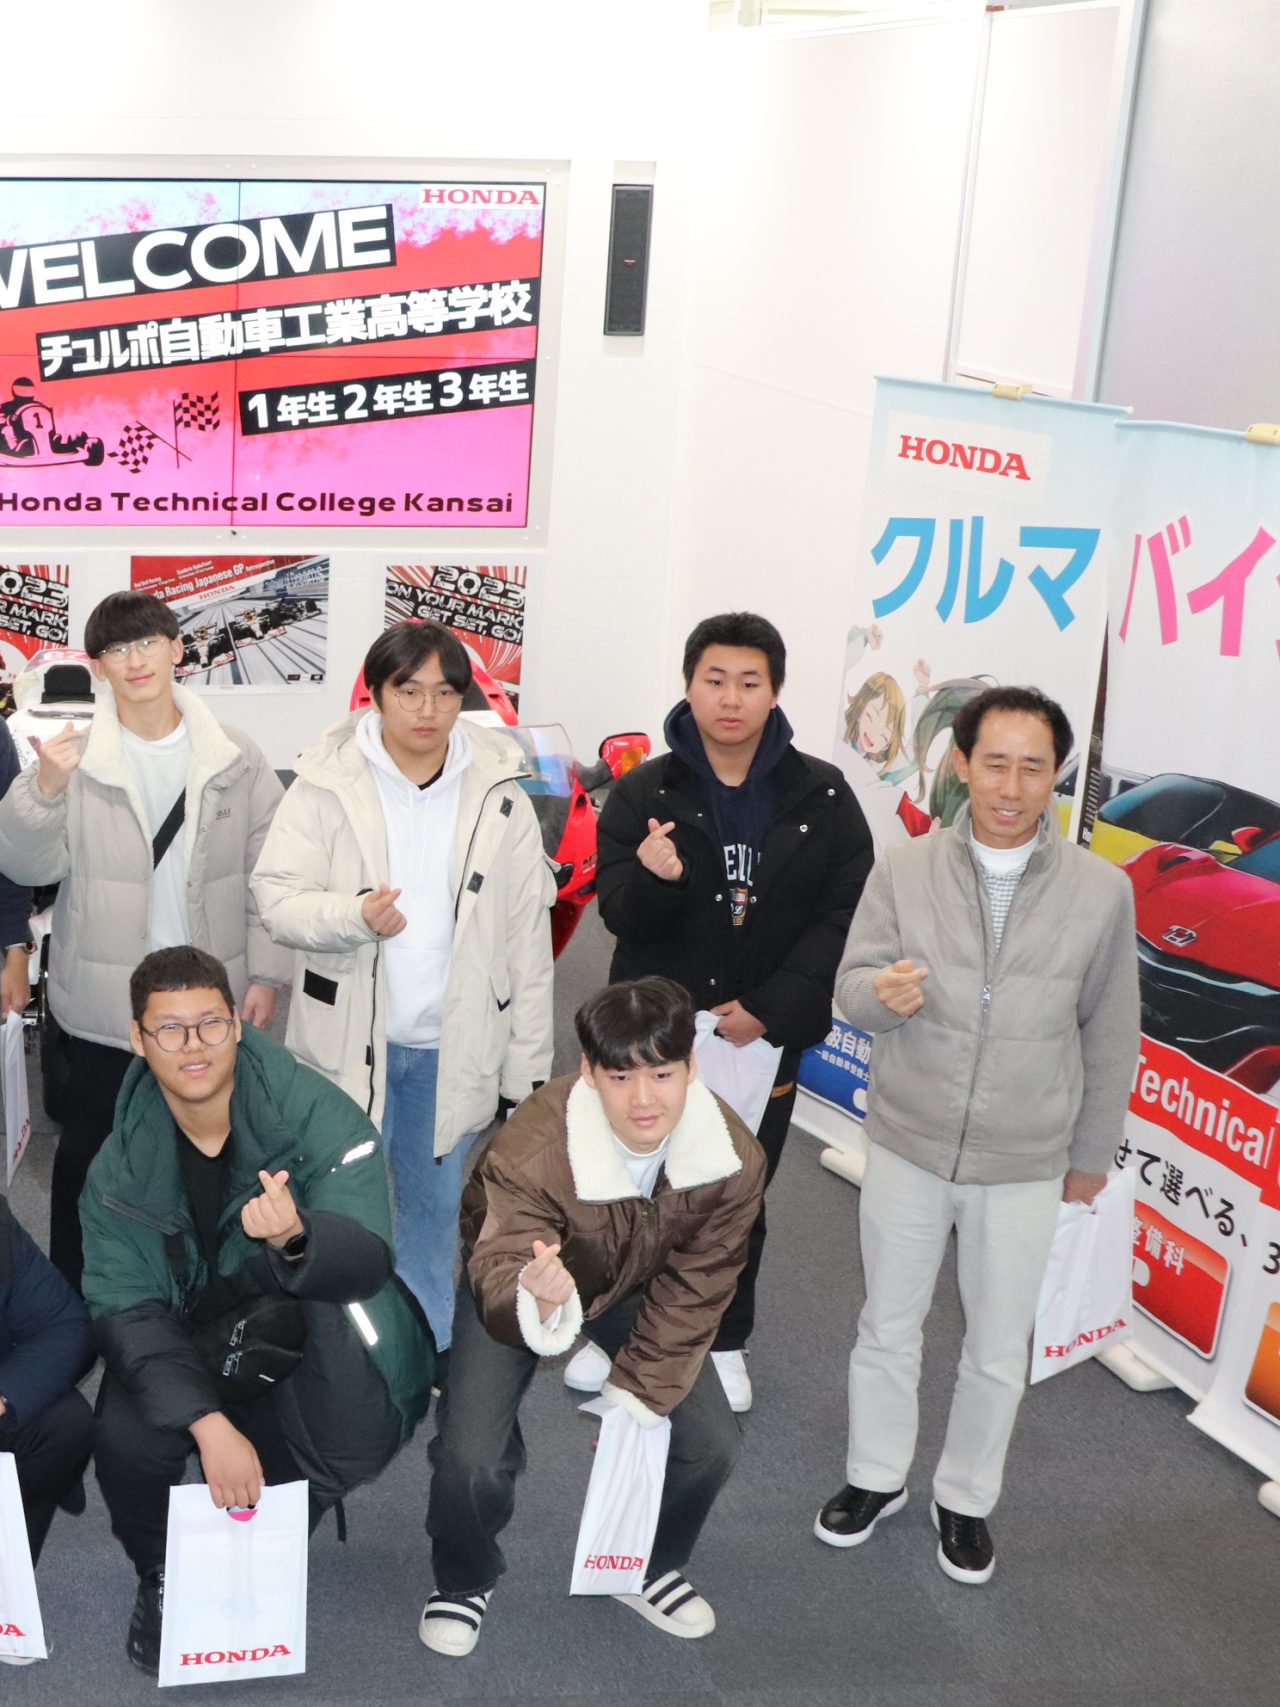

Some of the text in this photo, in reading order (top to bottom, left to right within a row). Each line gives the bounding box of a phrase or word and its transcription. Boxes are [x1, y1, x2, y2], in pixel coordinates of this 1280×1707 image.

[422, 188, 541, 205] HONDA
[40, 280, 533, 377] チュルポ自動車工業高等学校
[33, 412, 43, 429] 1
[898, 434, 1031, 481] HONDA
[111, 491, 268, 512] Technical
[276, 492, 396, 517] College
[404, 492, 513, 513] Kansai
[165, 581, 194, 596] Racing
[195, 568, 233, 588] Japanese
[233, 564, 244, 575] GP
[432, 566, 525, 609] 2023
[870, 515, 1101, 632] クルマ
[1118, 515, 1280, 658] バイ
[386, 580, 413, 599] ON
[416, 588, 465, 614] YOUR
[417, 604, 453, 625] GET
[1130, 1053, 1275, 1170] Technical
[1043, 1317, 1127, 1359] HONDA
[583, 1554, 645, 1571] HONDA
[179, 1643, 292, 1667] HONDA
